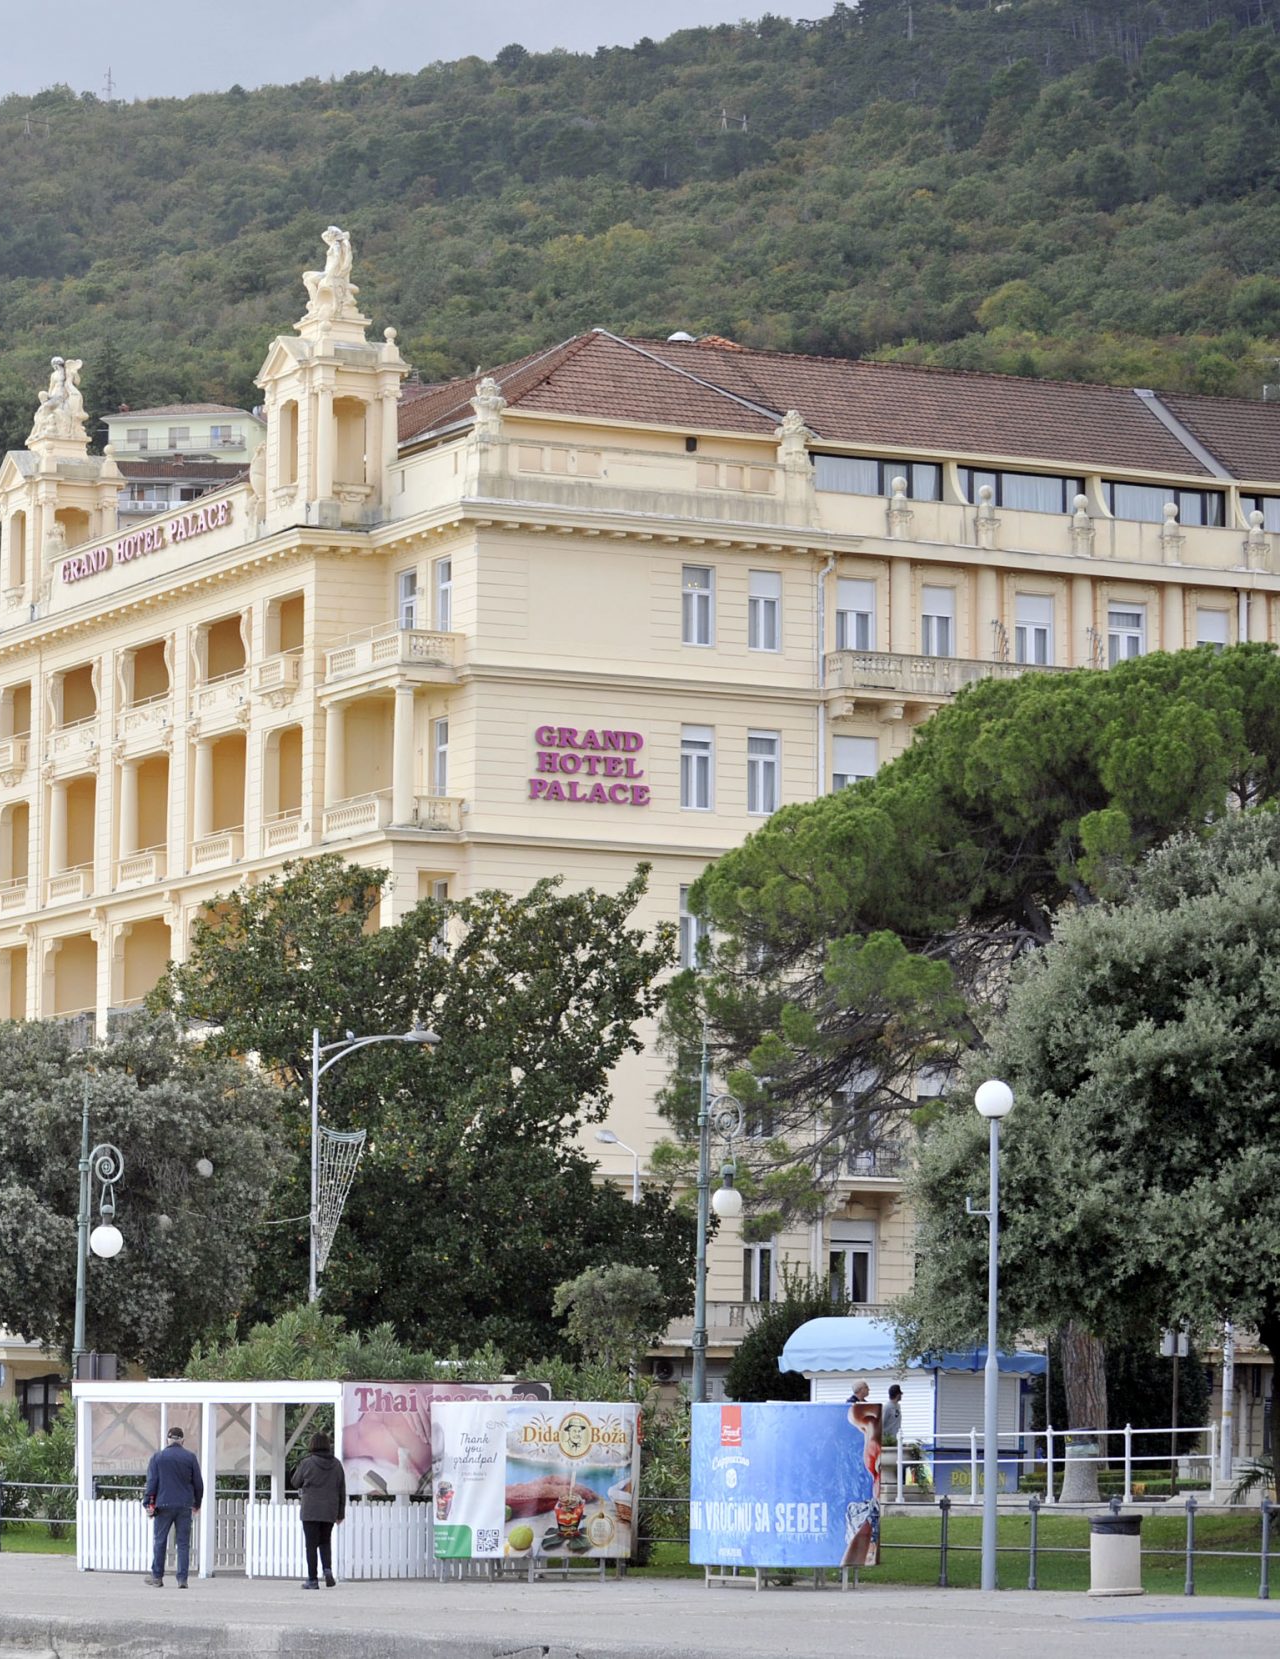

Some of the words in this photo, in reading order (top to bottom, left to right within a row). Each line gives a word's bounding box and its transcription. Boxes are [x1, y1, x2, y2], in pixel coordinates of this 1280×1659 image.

[61, 547, 112, 584] GRAND
[115, 526, 166, 564] HOTEL
[169, 500, 233, 545] PALACE
[535, 726, 644, 752] GRAND
[536, 752, 644, 779] HOTEL
[528, 778, 651, 806] PALACE
[355, 1387, 419, 1413] Thai
[460, 1432, 489, 1446] Thank
[523, 1425, 560, 1443] Dida
[453, 1452, 498, 1470] grandpa!
[465, 1446, 482, 1457] you
[754, 1502, 770, 1533] SA
[775, 1502, 828, 1534] SEBE!
